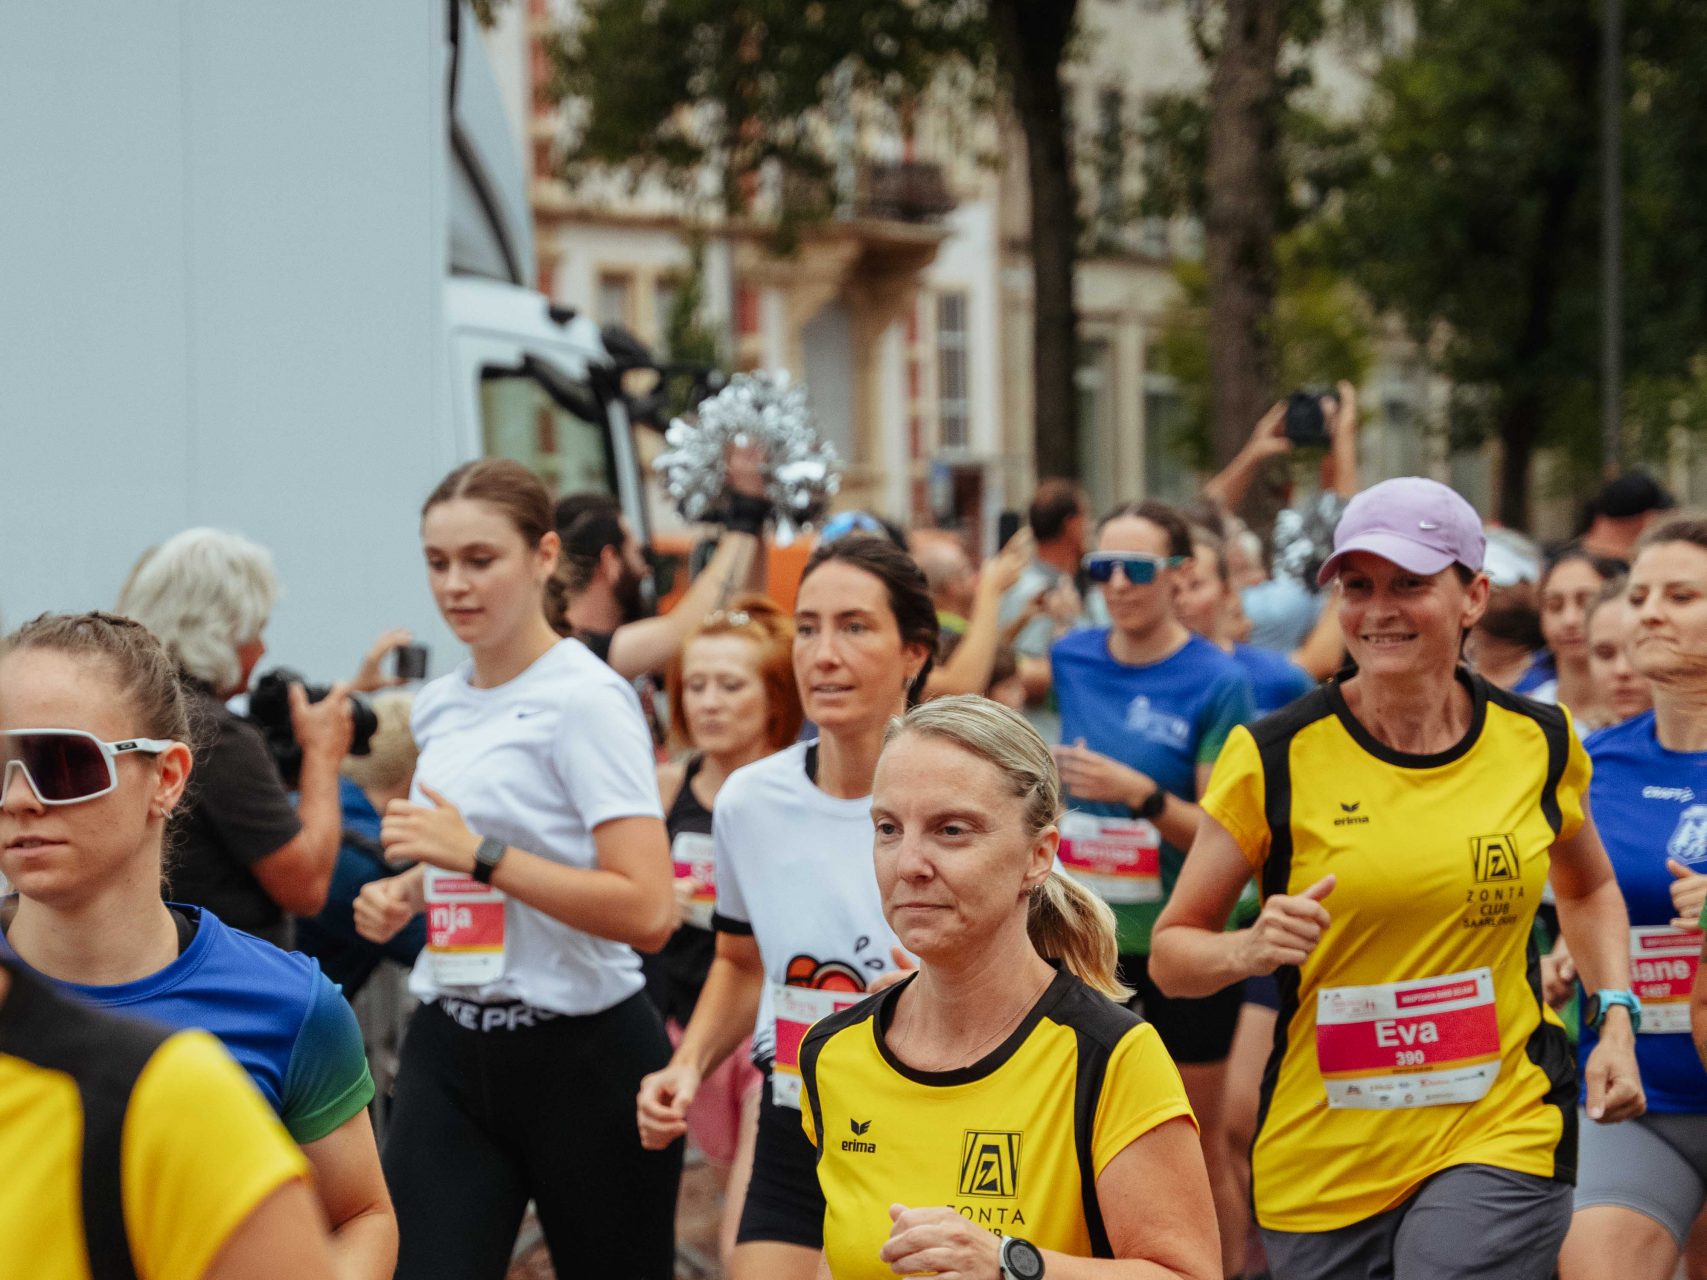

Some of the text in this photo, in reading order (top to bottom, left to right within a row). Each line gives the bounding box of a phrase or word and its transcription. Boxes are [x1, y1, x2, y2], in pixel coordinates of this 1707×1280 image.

[1334, 815, 1369, 826] erima
[1467, 886, 1525, 903] ZONTA
[431, 902, 473, 934] nja
[1480, 903, 1510, 917] CLUB
[1629, 959, 1691, 982] iane
[1375, 1019, 1439, 1048] Eva
[1395, 1050, 1425, 1066] 390
[841, 1139, 876, 1153] erima
[946, 1205, 1025, 1225] ONTA
